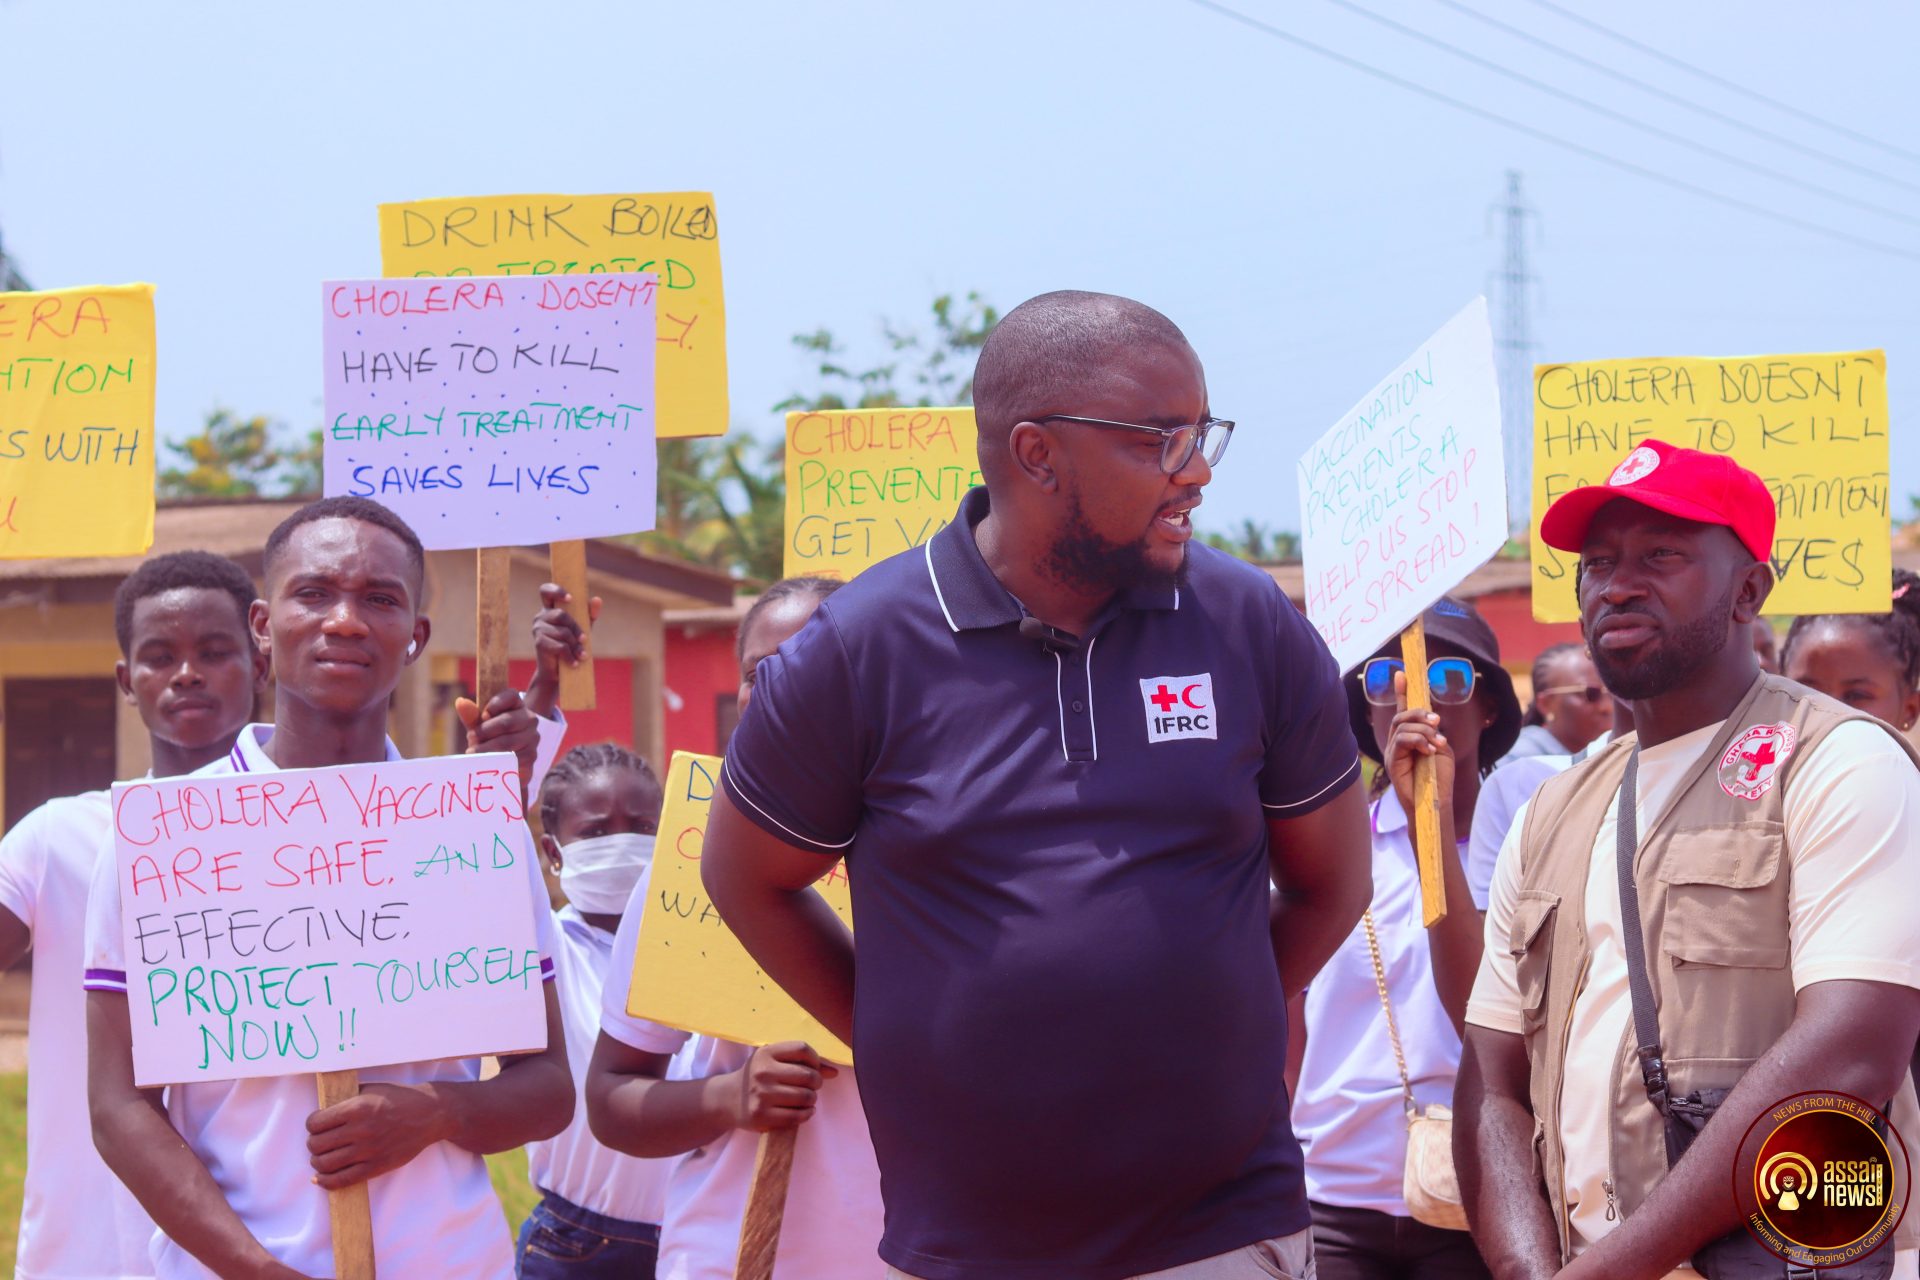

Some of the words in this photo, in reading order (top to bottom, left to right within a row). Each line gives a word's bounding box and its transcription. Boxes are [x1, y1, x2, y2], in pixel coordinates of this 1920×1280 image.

[403, 203, 589, 247] DRINK
[603, 198, 718, 240] BOILED
[331, 282, 504, 318] CHOLERA
[343, 347, 438, 383] HAVE
[450, 343, 498, 374] TO
[513, 343, 619, 373] KILL
[1538, 365, 1697, 410] CHOLERA
[1719, 358, 1874, 408] DOESN'T
[331, 406, 446, 442] EARLY
[457, 402, 643, 439] TREATMENT
[792, 411, 958, 456] CHOLERA
[1298, 351, 1433, 490] VACCINATION
[1544, 414, 1654, 458] HAVE
[1686, 417, 1736, 452] TO
[1758, 414, 1885, 450] KILL
[45, 427, 139, 465] WITH
[348, 465, 463, 497] SAVES
[487, 463, 600, 496] LIVES
[1306, 413, 1422, 540] PREVENTS
[1341, 425, 1460, 546] CHOLERA
[793, 514, 877, 559] GET
[1308, 540, 1369, 618] HELP
[1379, 515, 1407, 562] US
[1416, 447, 1477, 525] STOP
[1154, 714, 1210, 735] IFRC
[116, 780, 328, 846] CHOLERA
[339, 769, 526, 828] VACCINES
[131, 847, 243, 903] ARE
[414, 833, 515, 878] AND
[147, 962, 338, 1026] PROTECT
[353, 946, 542, 1004] YOURSELF
